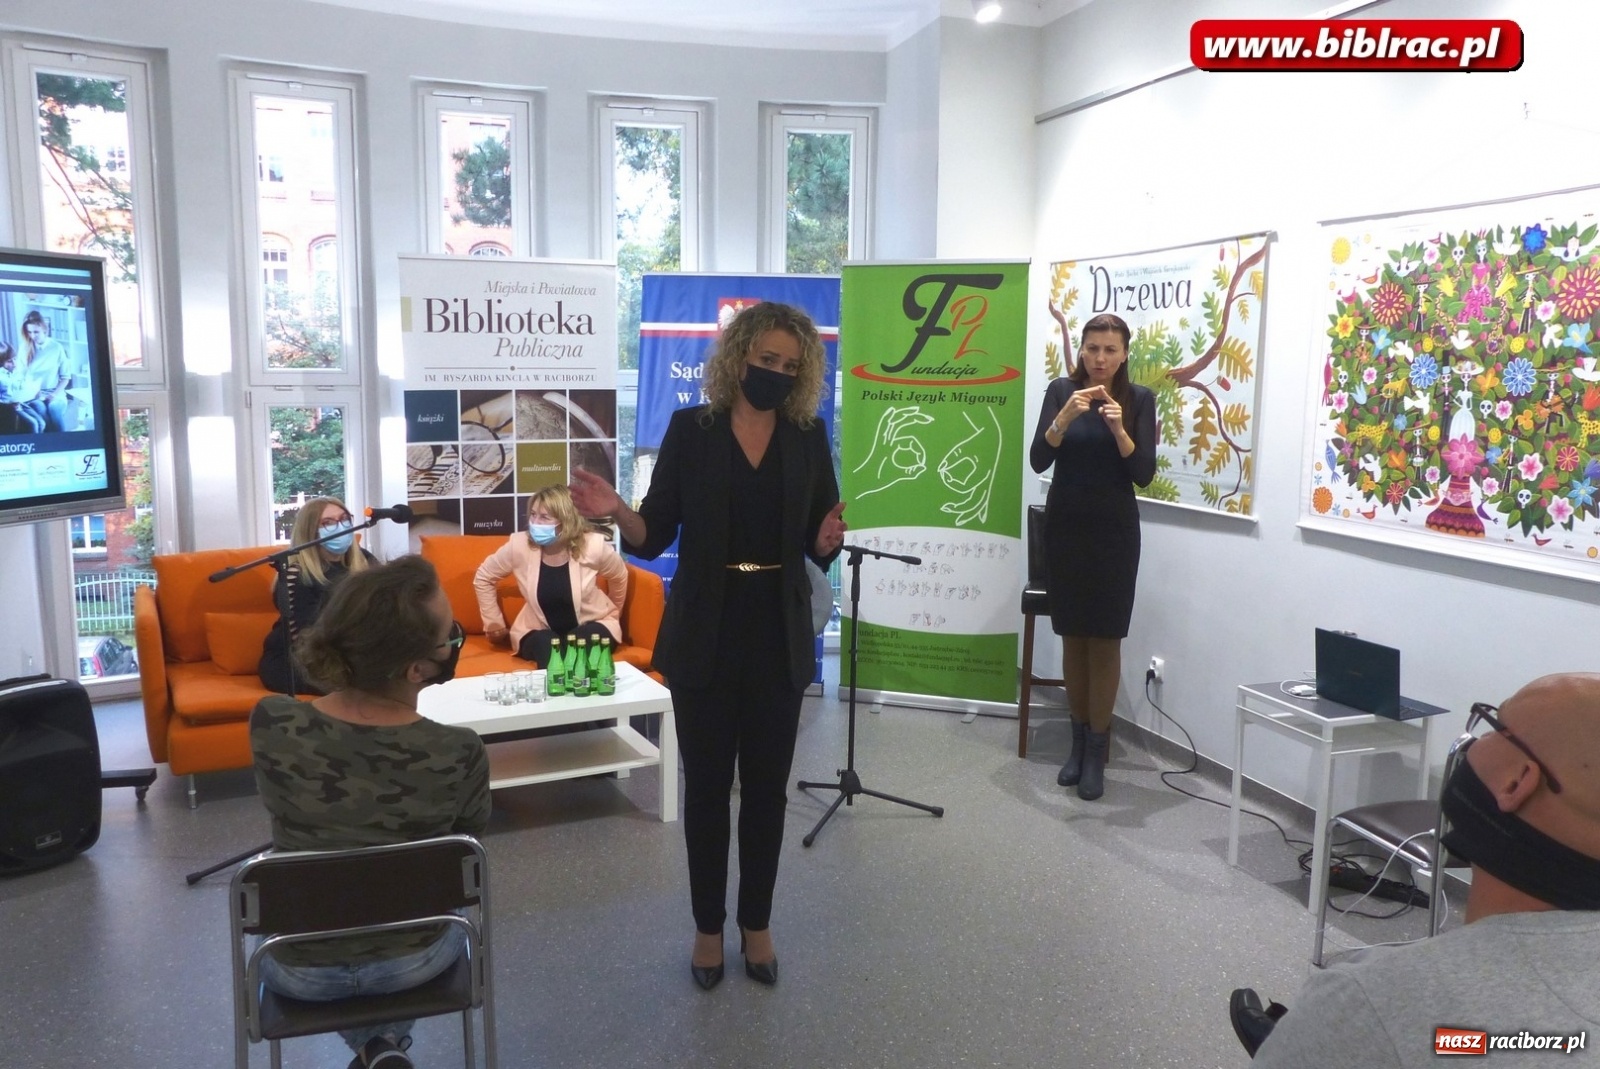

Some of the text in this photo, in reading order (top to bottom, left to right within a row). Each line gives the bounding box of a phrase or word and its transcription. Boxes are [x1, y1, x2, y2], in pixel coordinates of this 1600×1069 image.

[484, 280, 597, 297] Miejska i Powiatowa
[1089, 265, 1192, 313] Drzewa
[423, 297, 597, 336] Biblioteka
[493, 337, 583, 360] Publiczna
[443, 374, 493, 383] RYSZARDA
[532, 374, 541, 382] W
[544, 374, 598, 382] RACIBORZU
[670, 361, 704, 382] Sąd
[677, 392, 693, 404] w
[862, 390, 1007, 406] Polski Język Migowy
[417, 413, 445, 424] książki
[521, 463, 561, 473] multimedia
[473, 519, 503, 530] muzyka
[859, 629, 889, 640] undacja
